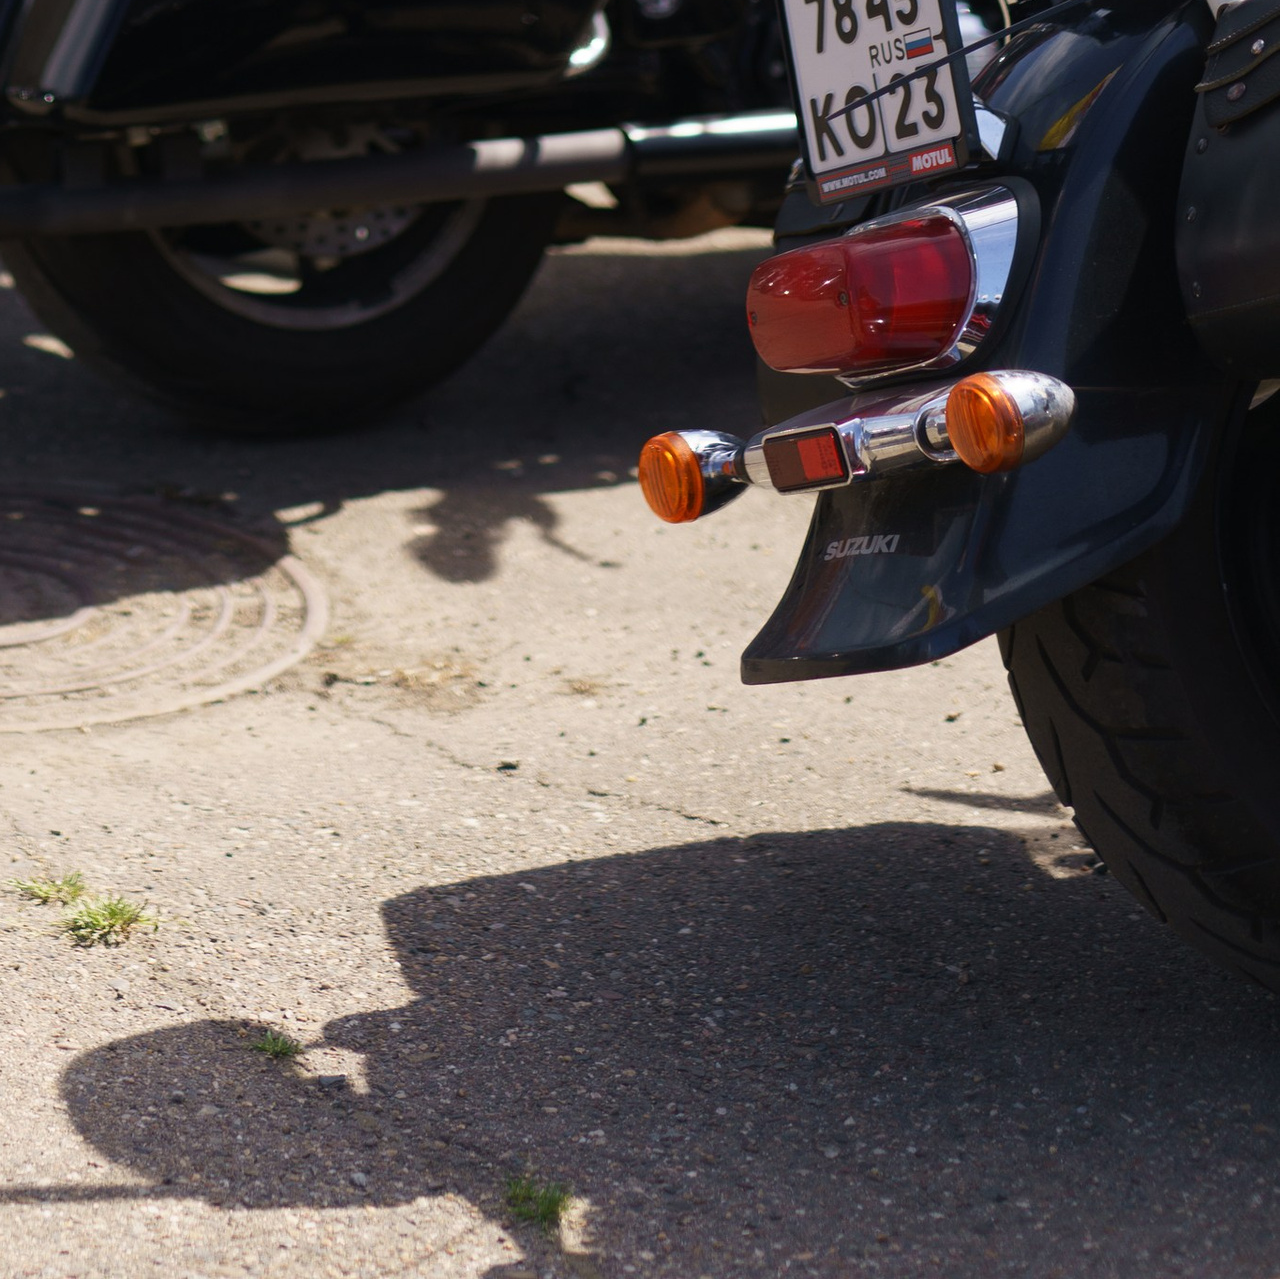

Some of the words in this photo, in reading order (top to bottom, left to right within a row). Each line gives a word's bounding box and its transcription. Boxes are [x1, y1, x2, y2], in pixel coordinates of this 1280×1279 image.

[868, 38, 906, 69] RUS
[911, 147, 953, 172] MOTUL
[824, 533, 901, 562] SUZUKI
